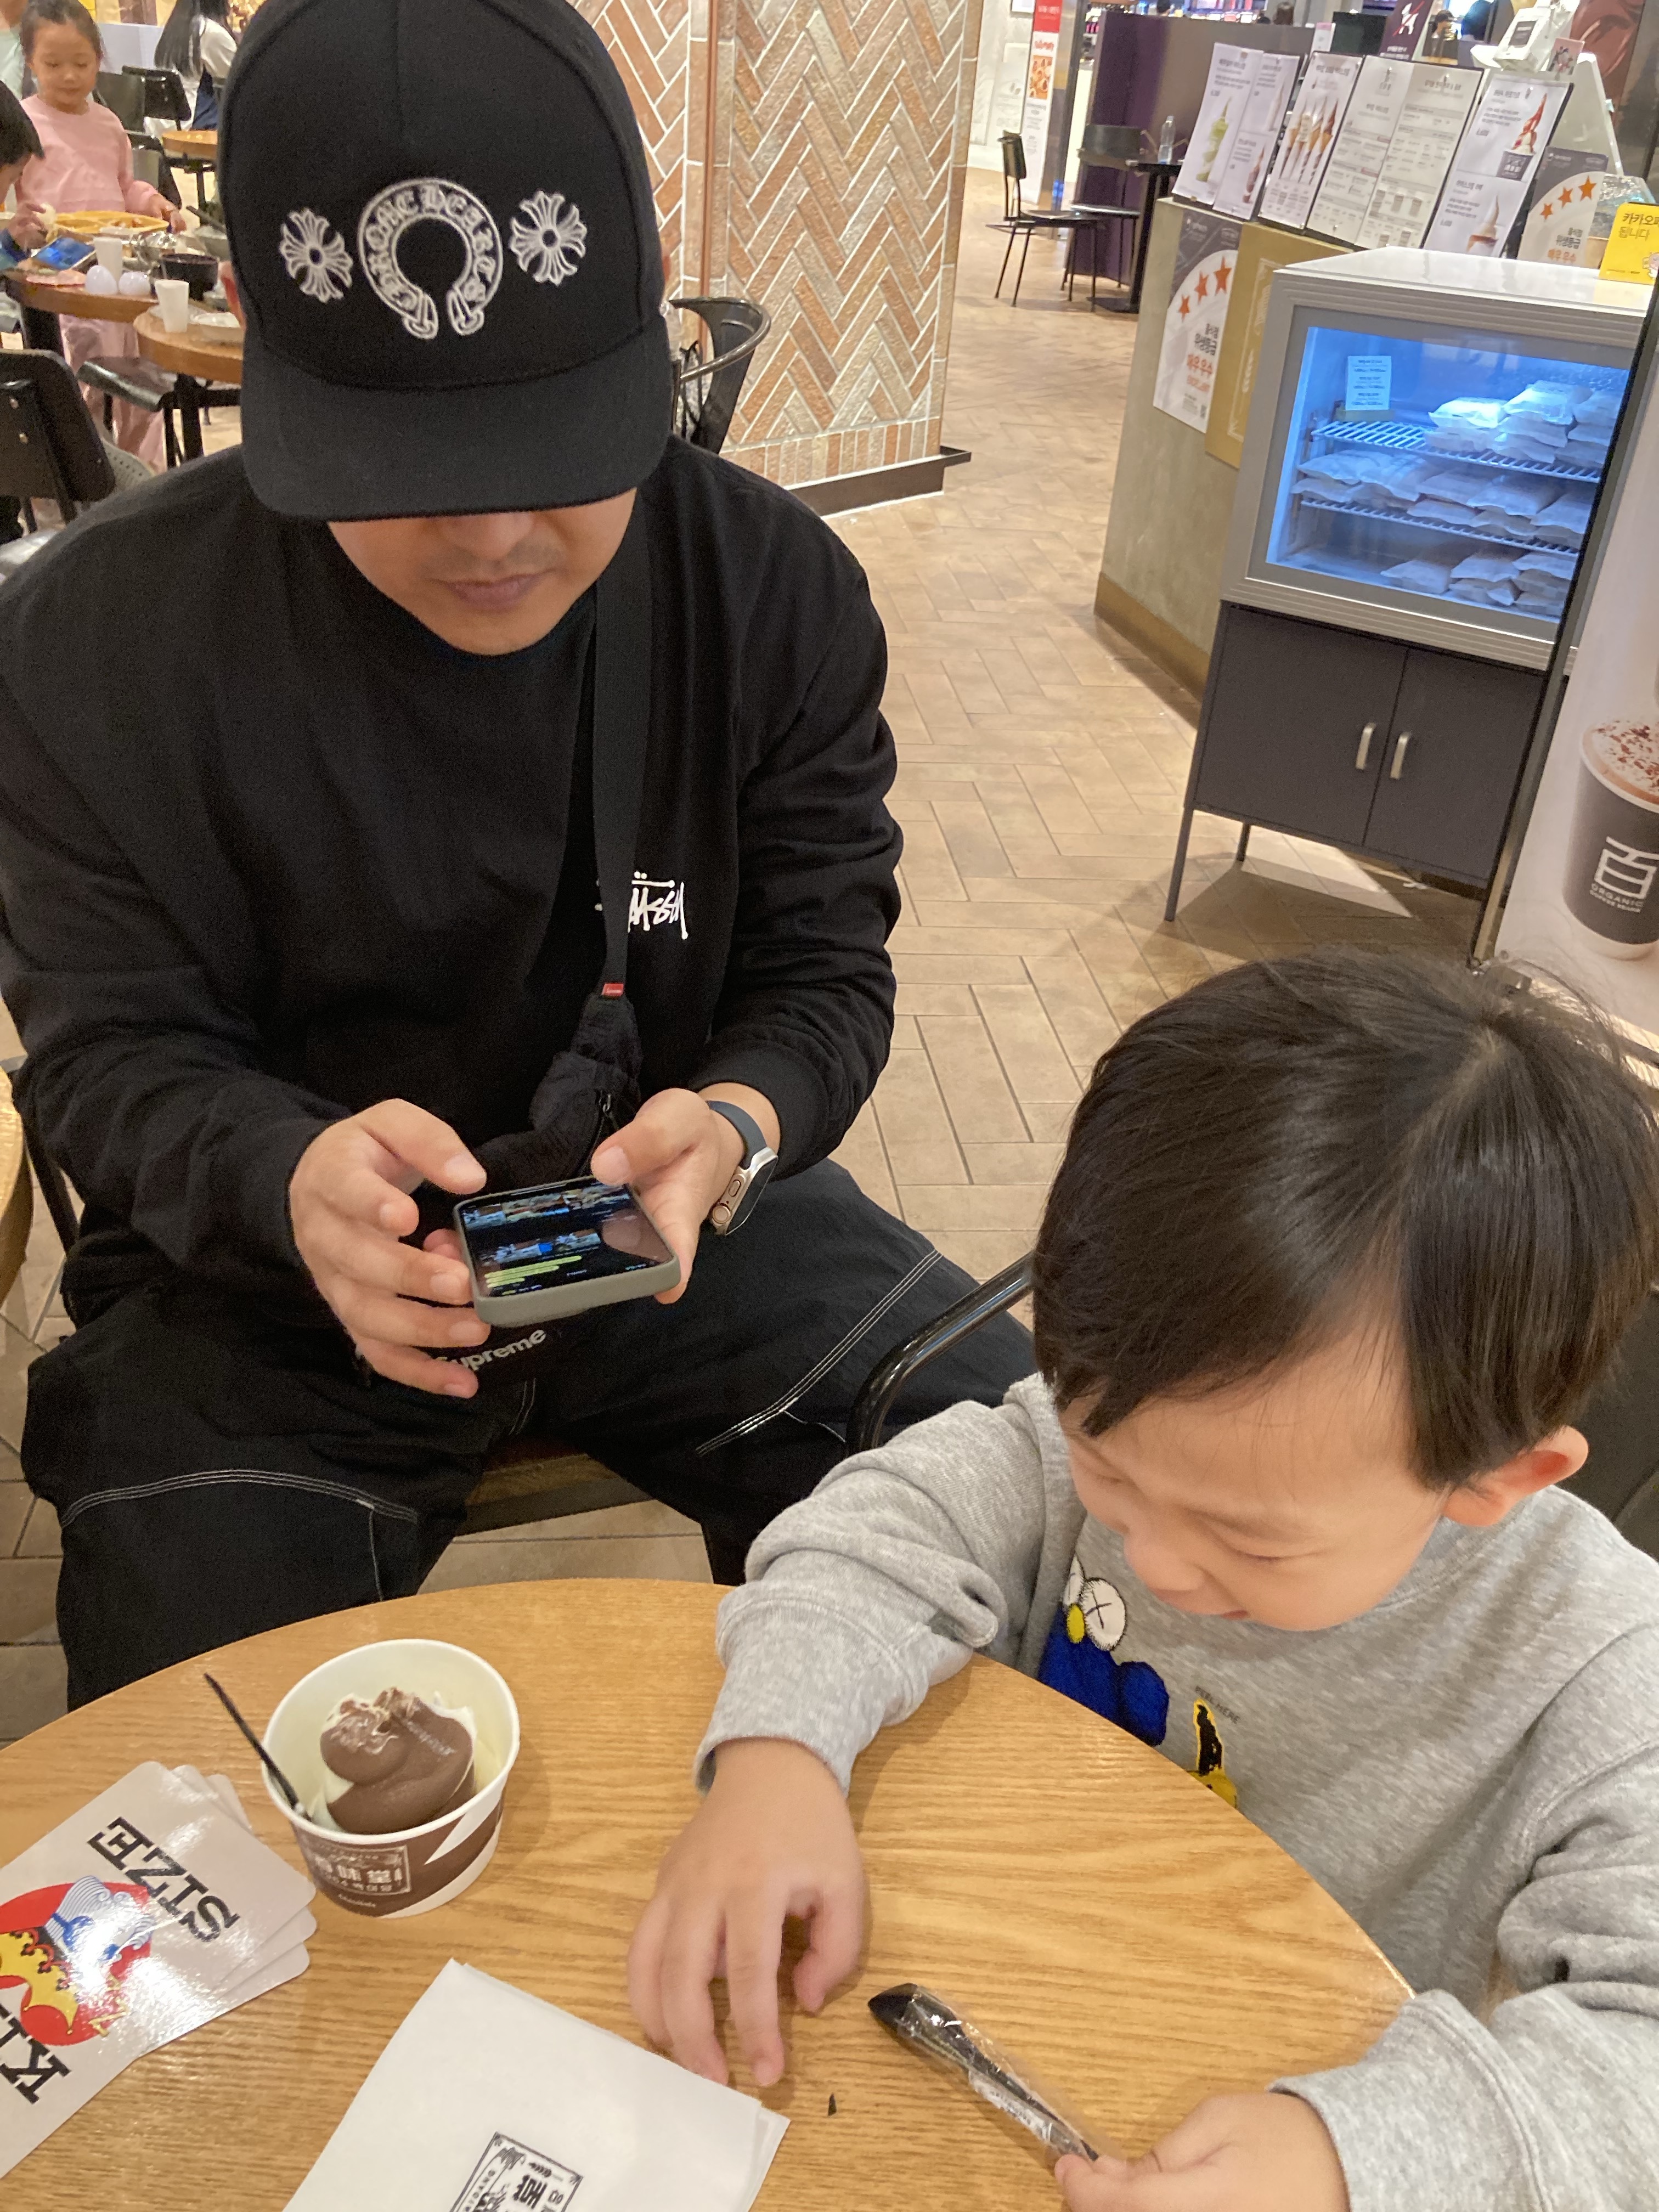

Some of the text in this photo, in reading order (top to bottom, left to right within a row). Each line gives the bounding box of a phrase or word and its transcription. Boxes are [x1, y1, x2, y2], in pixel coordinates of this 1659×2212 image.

[1618, 226, 1651, 241] 됩니다
[1591, 883, 1644, 908] ORGANIC
[436, 1329, 546, 1371] upreme
[87, 1816, 241, 1943] SIZE
